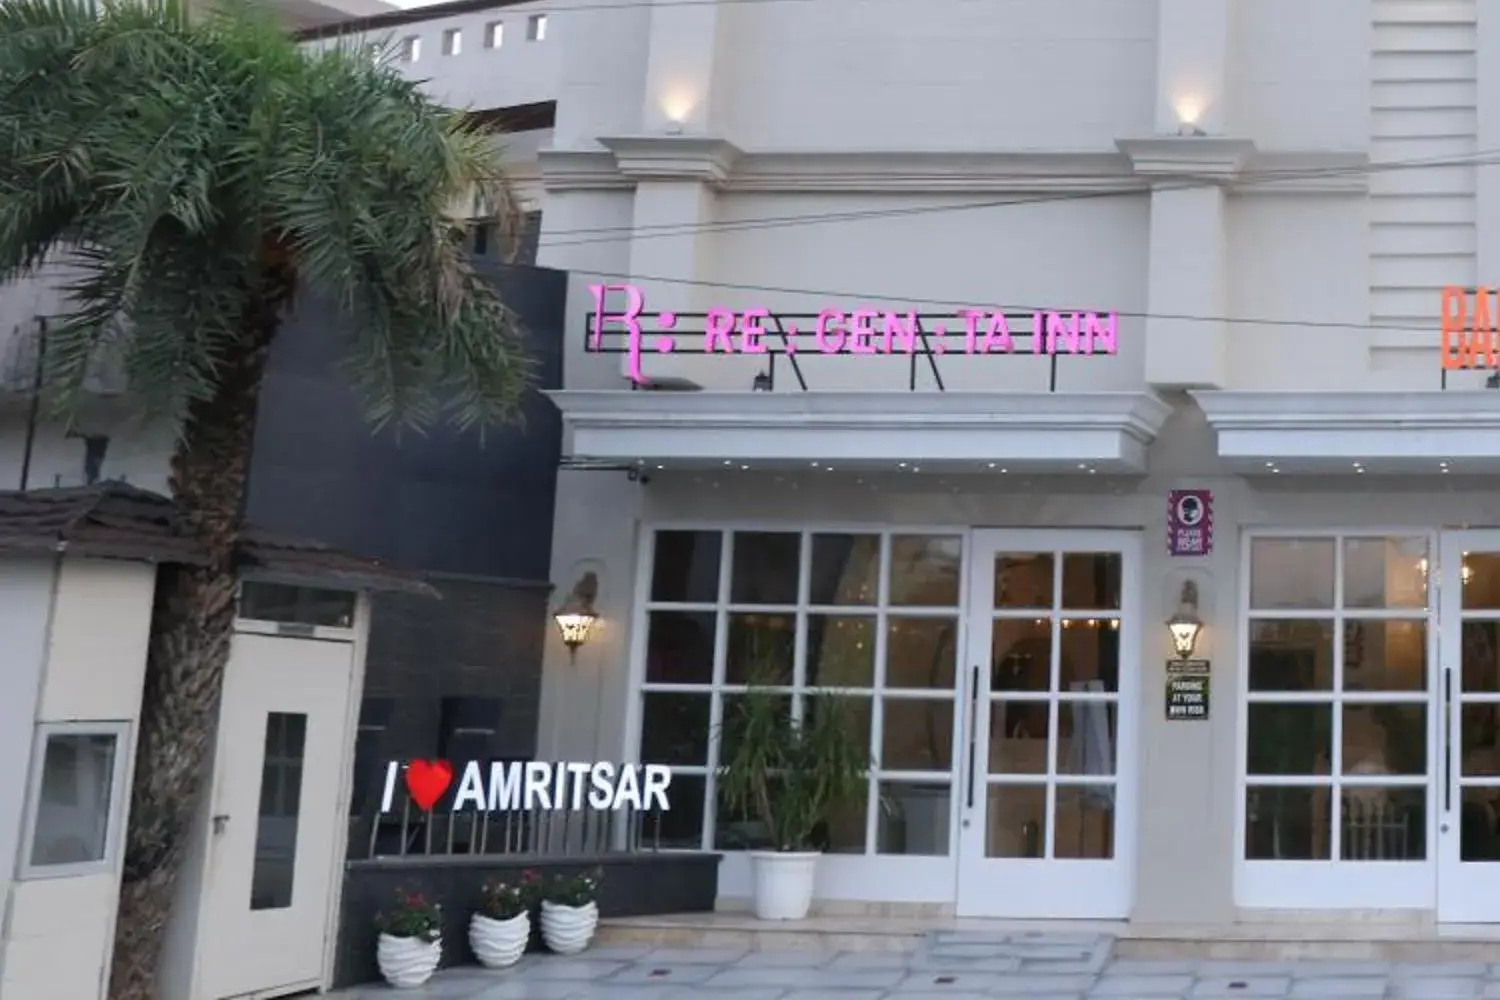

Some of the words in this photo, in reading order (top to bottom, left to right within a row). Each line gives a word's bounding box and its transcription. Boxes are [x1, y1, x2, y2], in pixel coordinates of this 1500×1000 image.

[1033, 310, 1118, 355] INN
[381, 760, 398, 813] I
[452, 760, 672, 812] AMRITSAR
